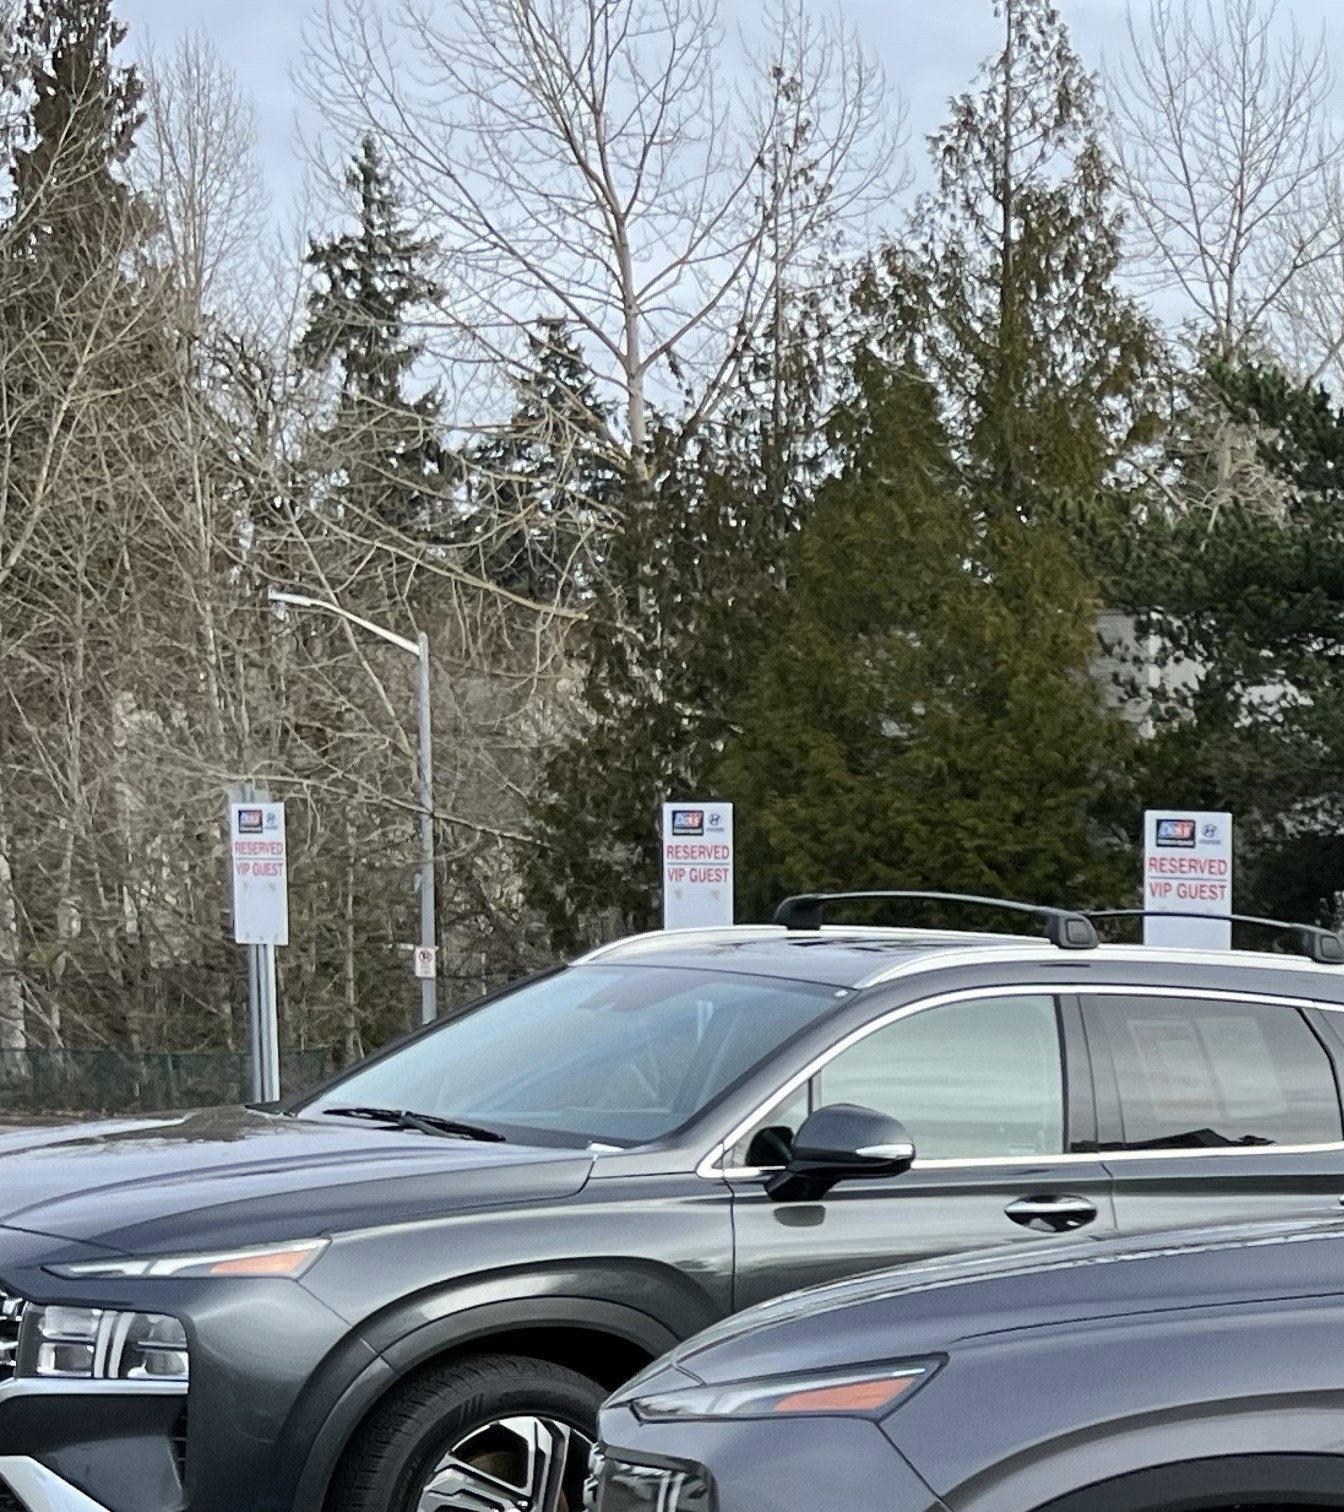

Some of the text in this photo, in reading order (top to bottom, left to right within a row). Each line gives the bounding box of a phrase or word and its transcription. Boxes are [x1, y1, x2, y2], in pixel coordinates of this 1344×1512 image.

[234, 841, 283, 856] RESERVED
[666, 845, 730, 860] RESERVED
[252, 862, 283, 877] GUEST
[1148, 857, 1228, 876] RESERVED
[667, 867, 729, 883] VIP GUEST
[1149, 882, 1227, 901] VIP GUEST
